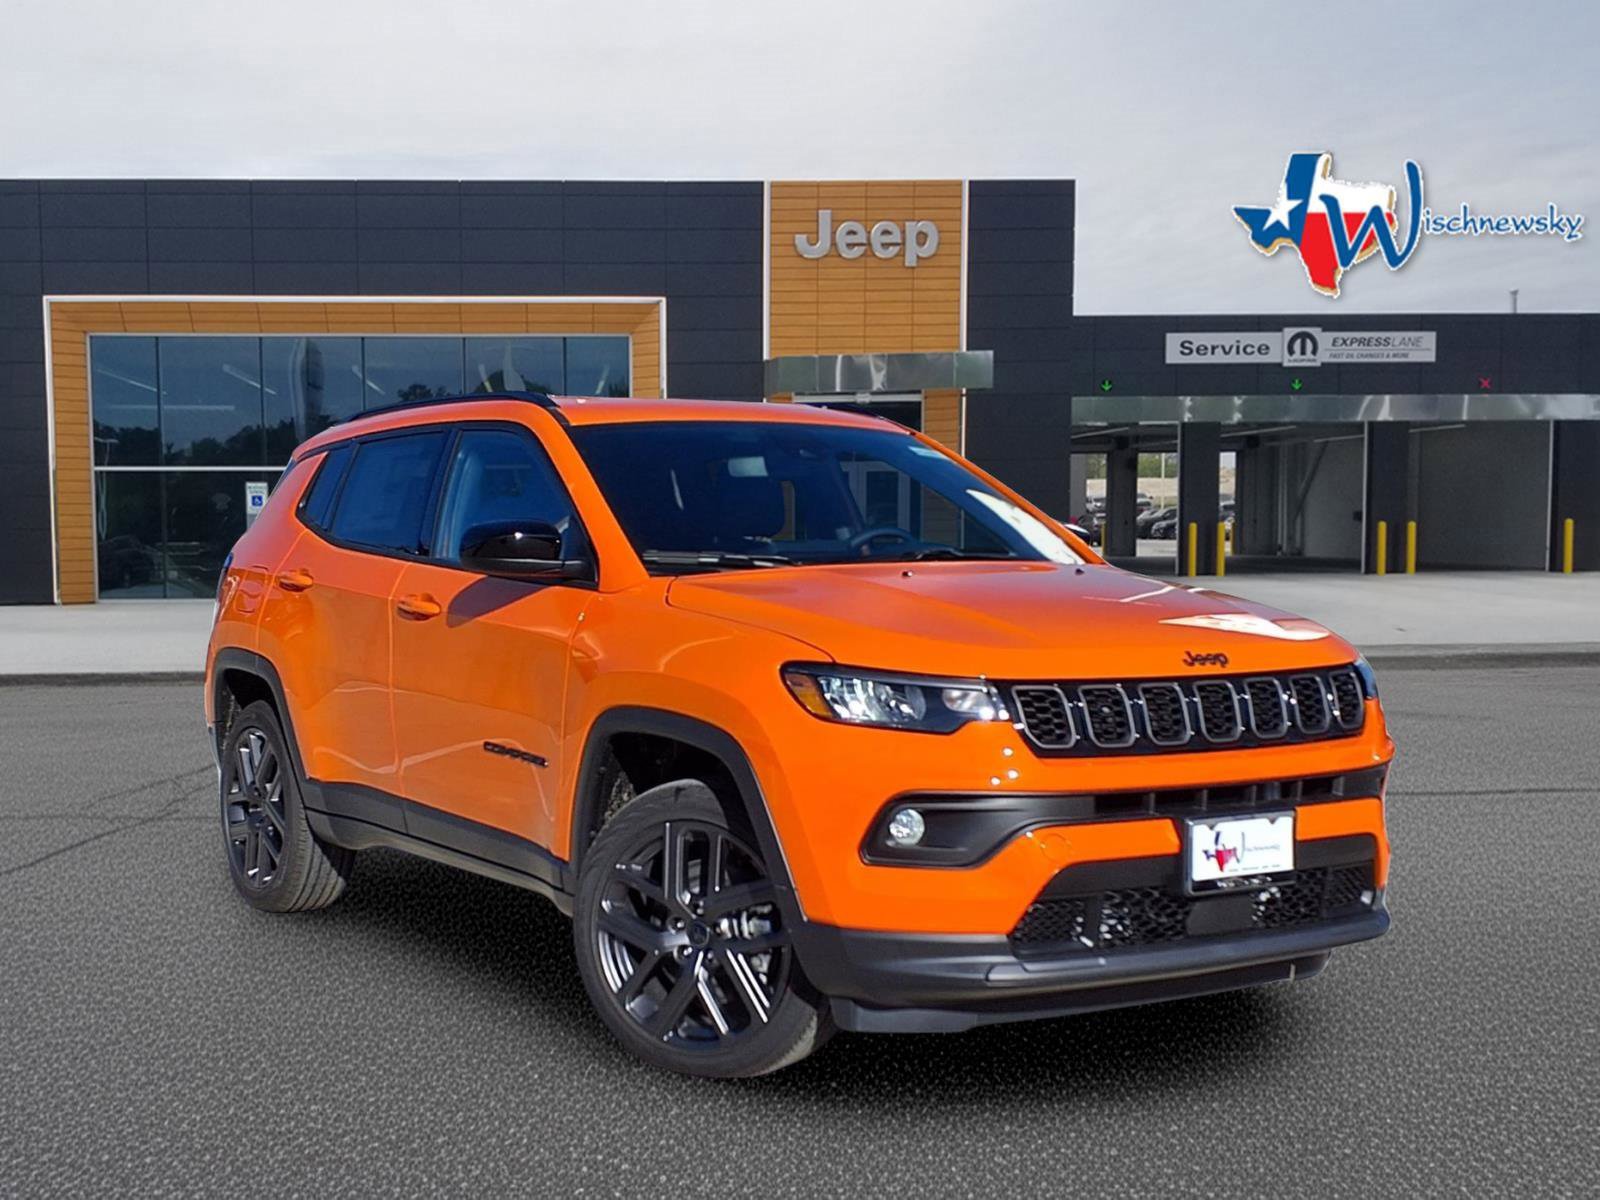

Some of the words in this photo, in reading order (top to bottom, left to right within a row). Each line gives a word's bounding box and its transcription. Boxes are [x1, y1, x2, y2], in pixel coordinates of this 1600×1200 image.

[794, 209, 940, 268] Jeep
[1179, 340, 1271, 356] Service
[1182, 650, 1229, 668] Jeep
